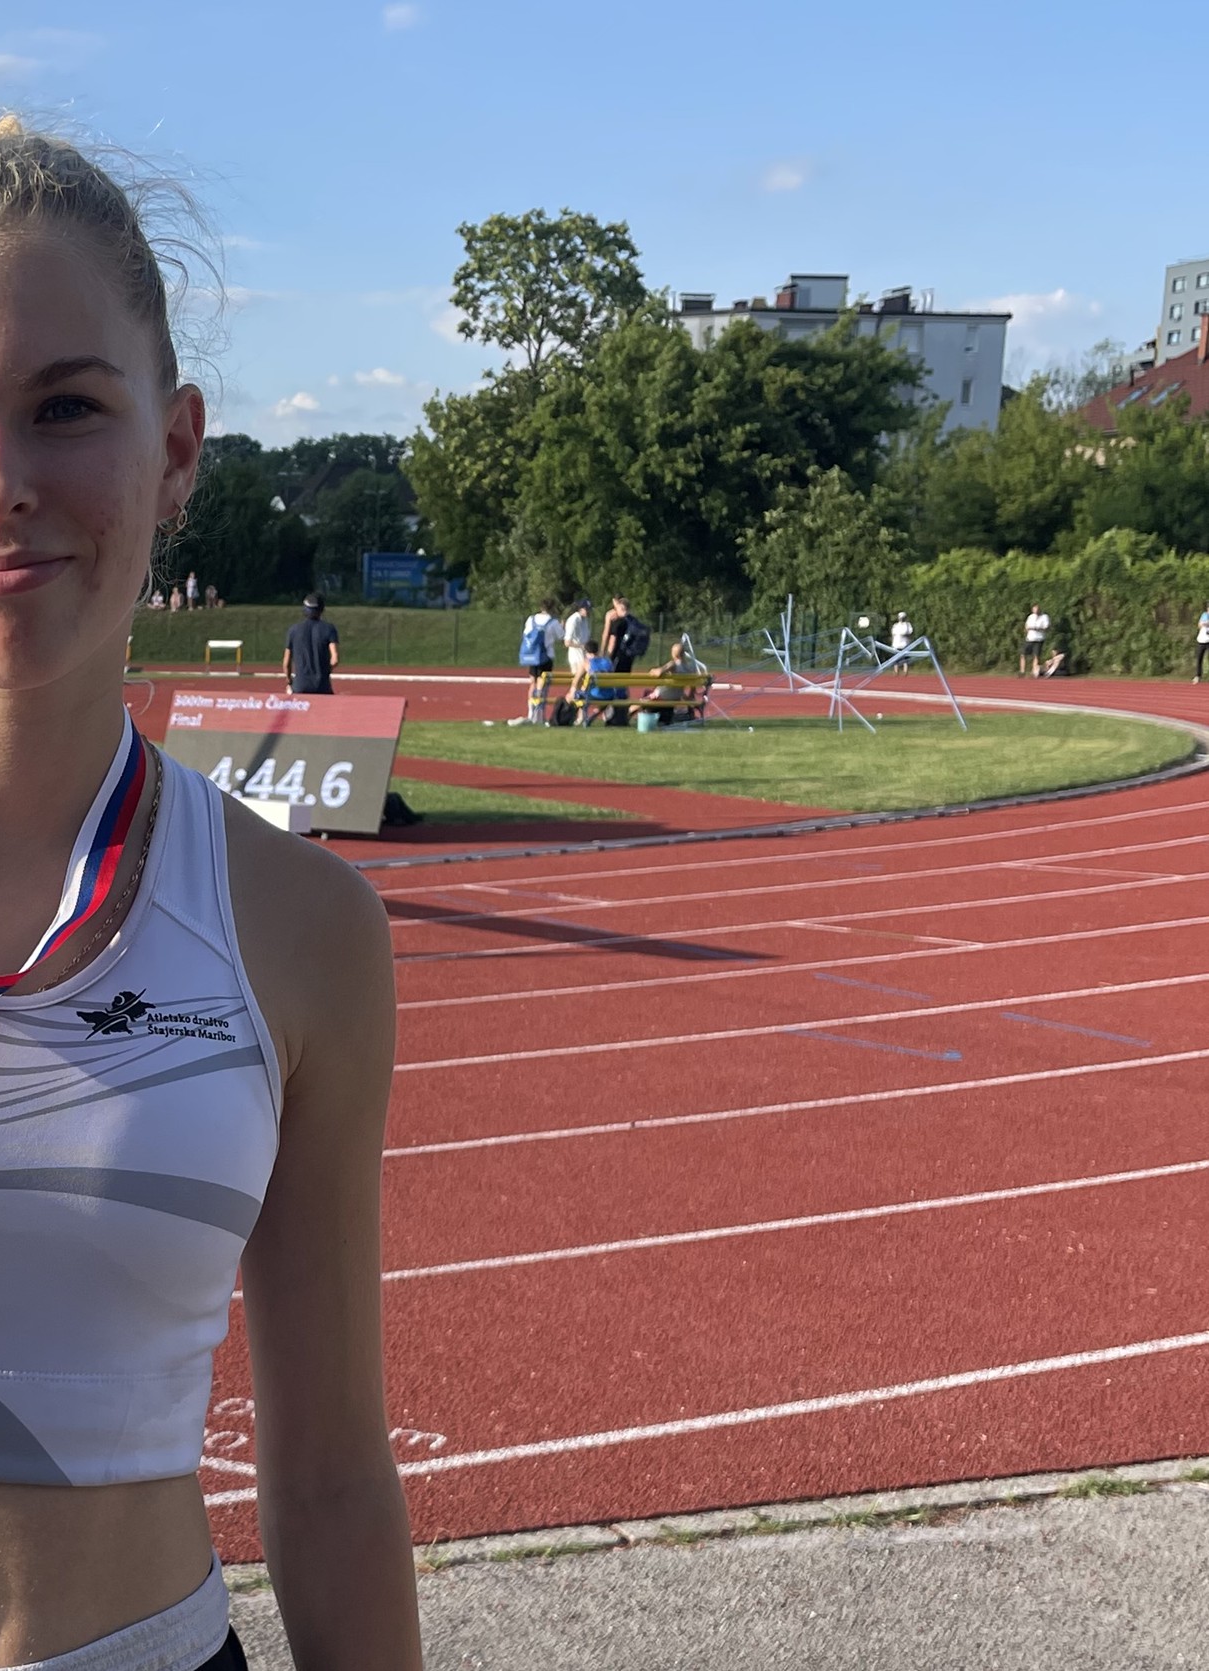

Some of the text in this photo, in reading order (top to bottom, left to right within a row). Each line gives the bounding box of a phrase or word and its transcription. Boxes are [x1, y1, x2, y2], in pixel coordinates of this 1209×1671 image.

[170, 712, 203, 727] Final
[207, 756, 354, 809] 4:44.6
[146, 1013, 230, 1028] Atletsko društvo
[148, 1025, 236, 1042] Štajerska Maribor
